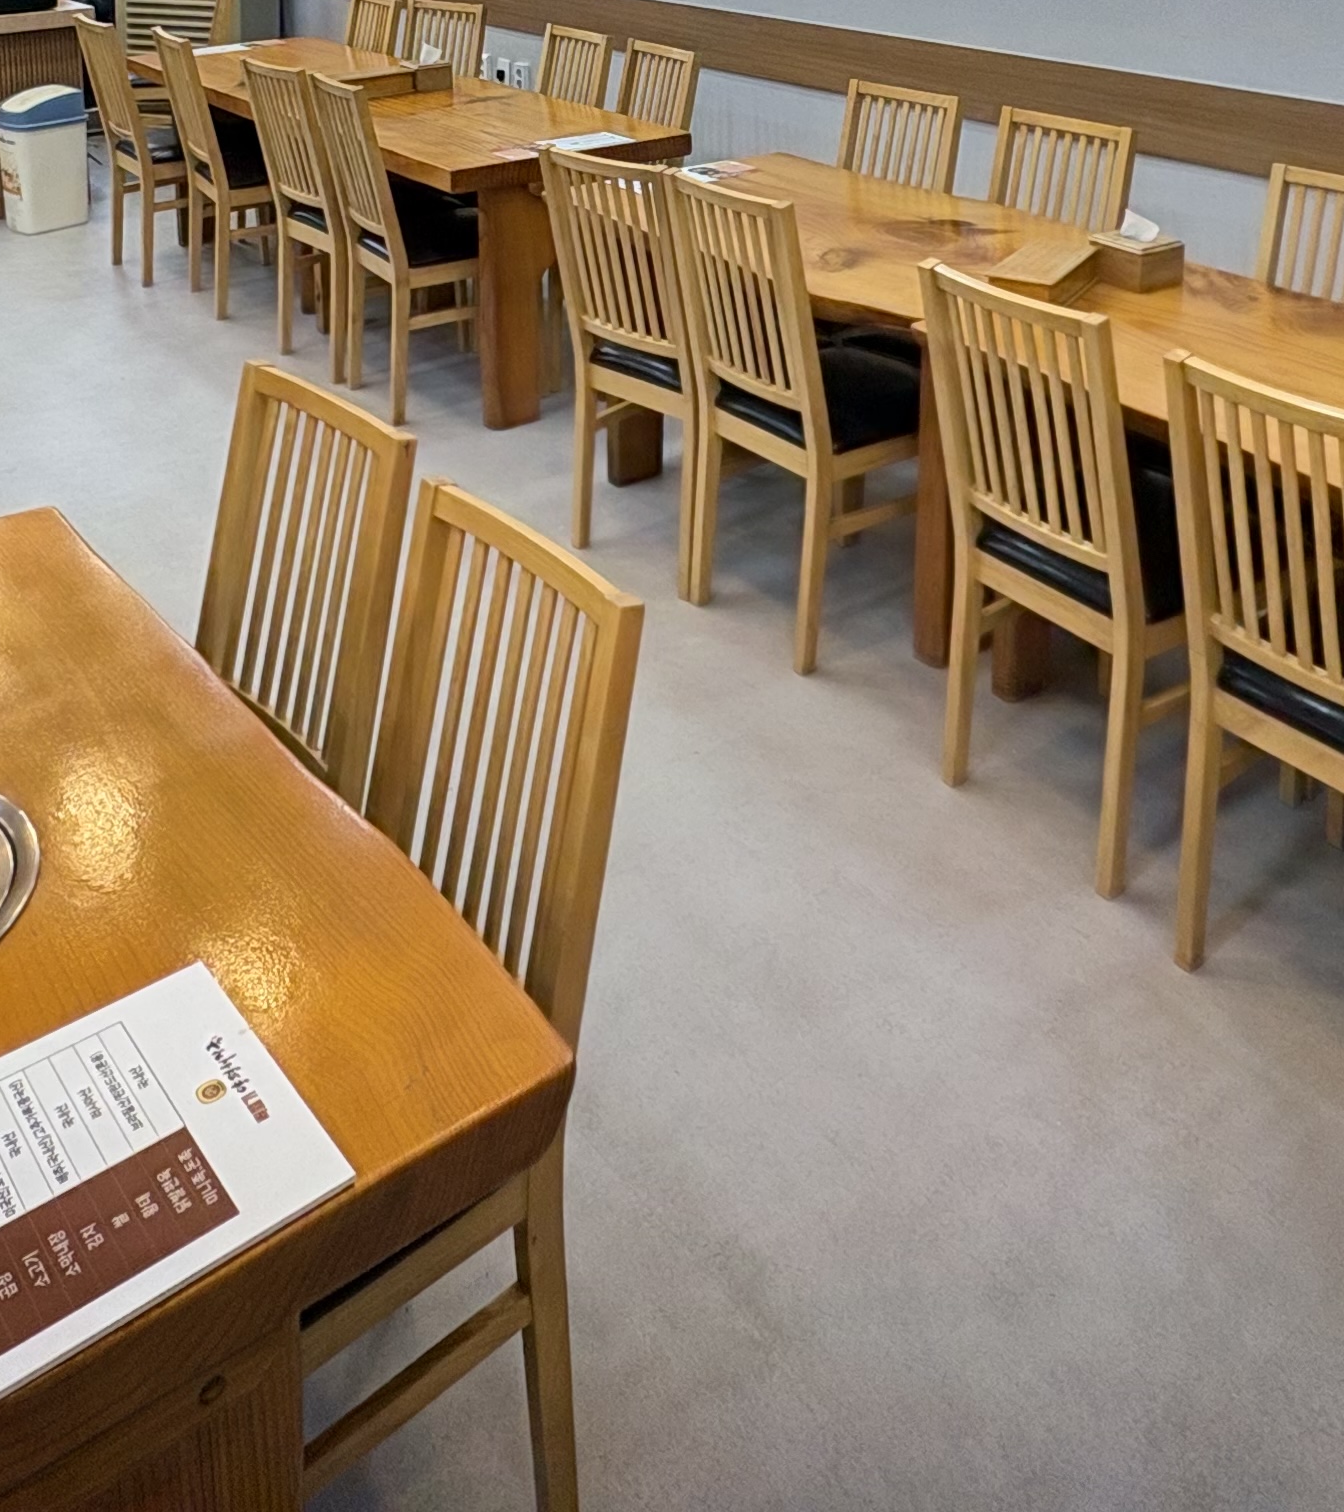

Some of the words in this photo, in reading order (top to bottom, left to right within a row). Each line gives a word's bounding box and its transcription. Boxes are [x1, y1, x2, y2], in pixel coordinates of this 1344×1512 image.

[129, 1063, 150, 1089] 국내산
[54, 1103, 75, 1129] 국내산
[1, 1130, 22, 1159] 국내산
[135, 1191, 159, 1219] 황태
[156, 1167, 192, 1214] 닭발편육
[80, 1222, 105, 1251] 김치
[47, 1230, 81, 1277] 소막내장
[22, 1250, 51, 1288] 소고기
